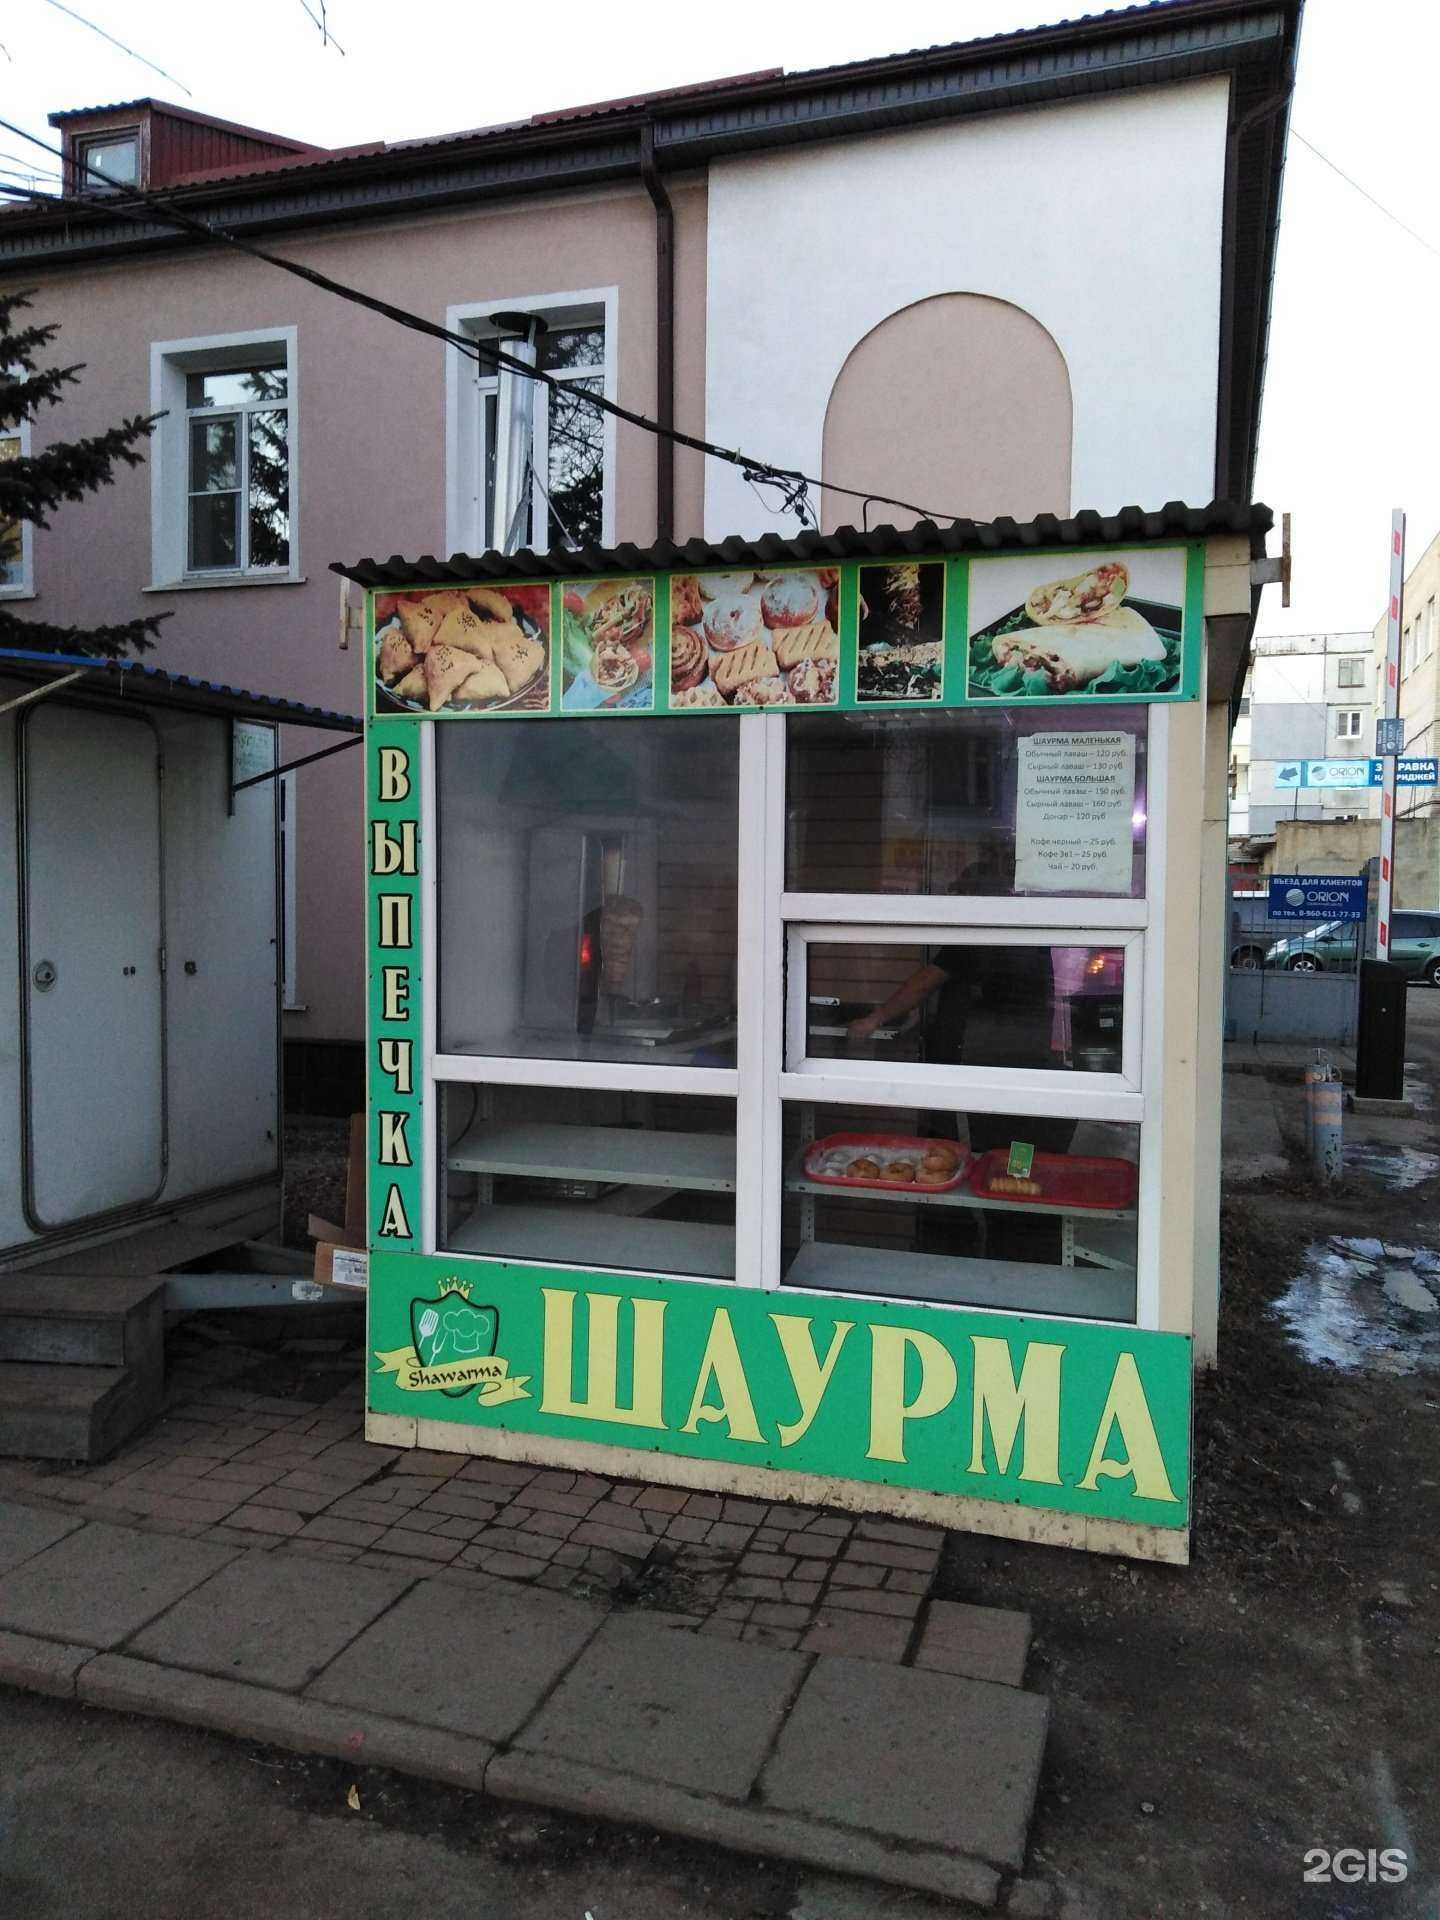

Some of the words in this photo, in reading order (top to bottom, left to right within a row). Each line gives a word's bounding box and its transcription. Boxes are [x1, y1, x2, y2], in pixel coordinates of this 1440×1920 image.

[1072, 737, 1121, 745] МАЛЕНЬКАЯ
[1329, 767, 1365, 777] ORION
[1375, 762, 1436, 772] ЗРАВКА
[1036, 775, 1072, 783] ШАУРМА
[1075, 775, 1115, 783] БОЛЬШАЯ
[1306, 891, 1349, 902] ORION
[371, 746, 418, 1238] ВЫПЕЧКА
[408, 1365, 502, 1388] Shawarma
[538, 1286, 1183, 1504] ШАУРМА
